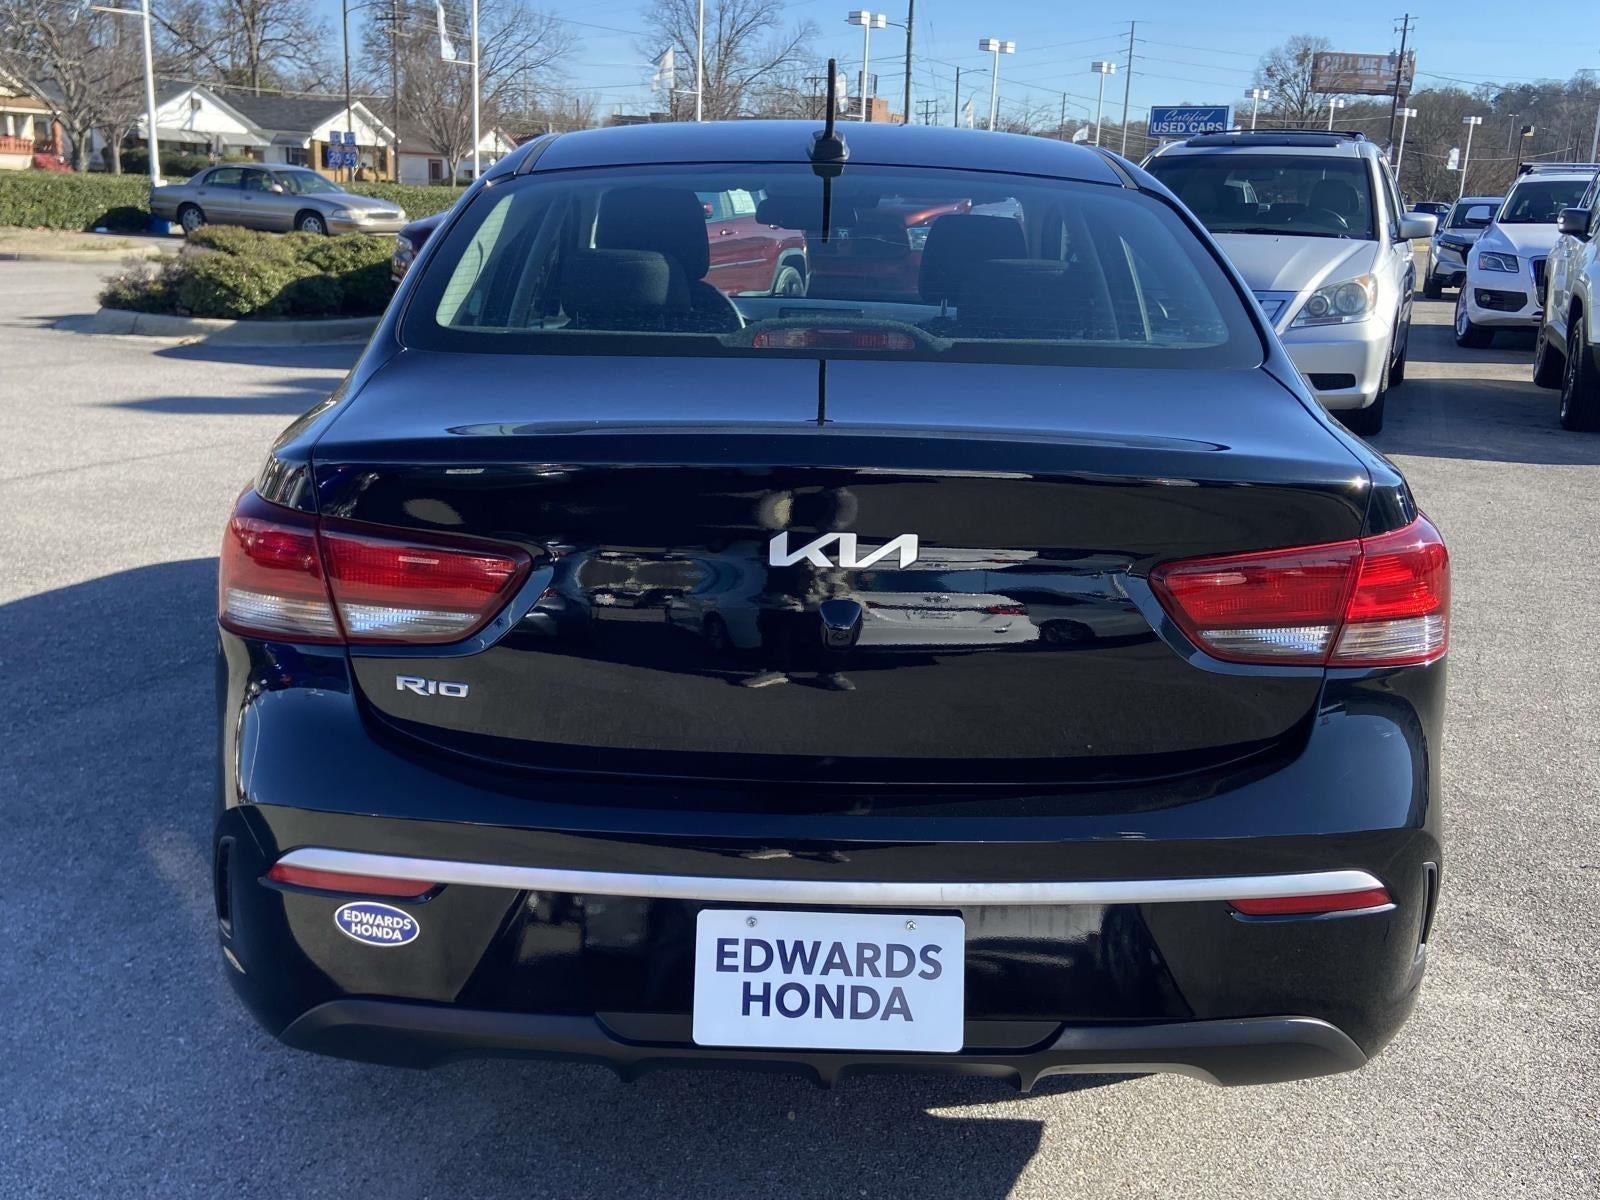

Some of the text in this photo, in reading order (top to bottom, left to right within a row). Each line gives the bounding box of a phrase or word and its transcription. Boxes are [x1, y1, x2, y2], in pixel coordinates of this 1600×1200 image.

[1357, 57, 1378, 75] ME
[1153, 122, 1223, 133] USED CARS
[1164, 109, 1216, 126] Certified
[769, 531, 919, 569] KIA
[396, 675, 469, 698] RIO
[343, 909, 411, 930] EDWARDS
[351, 922, 403, 941] HONDA
[716, 938, 942, 980] EDWARDS
[741, 981, 914, 1022] HONDA
